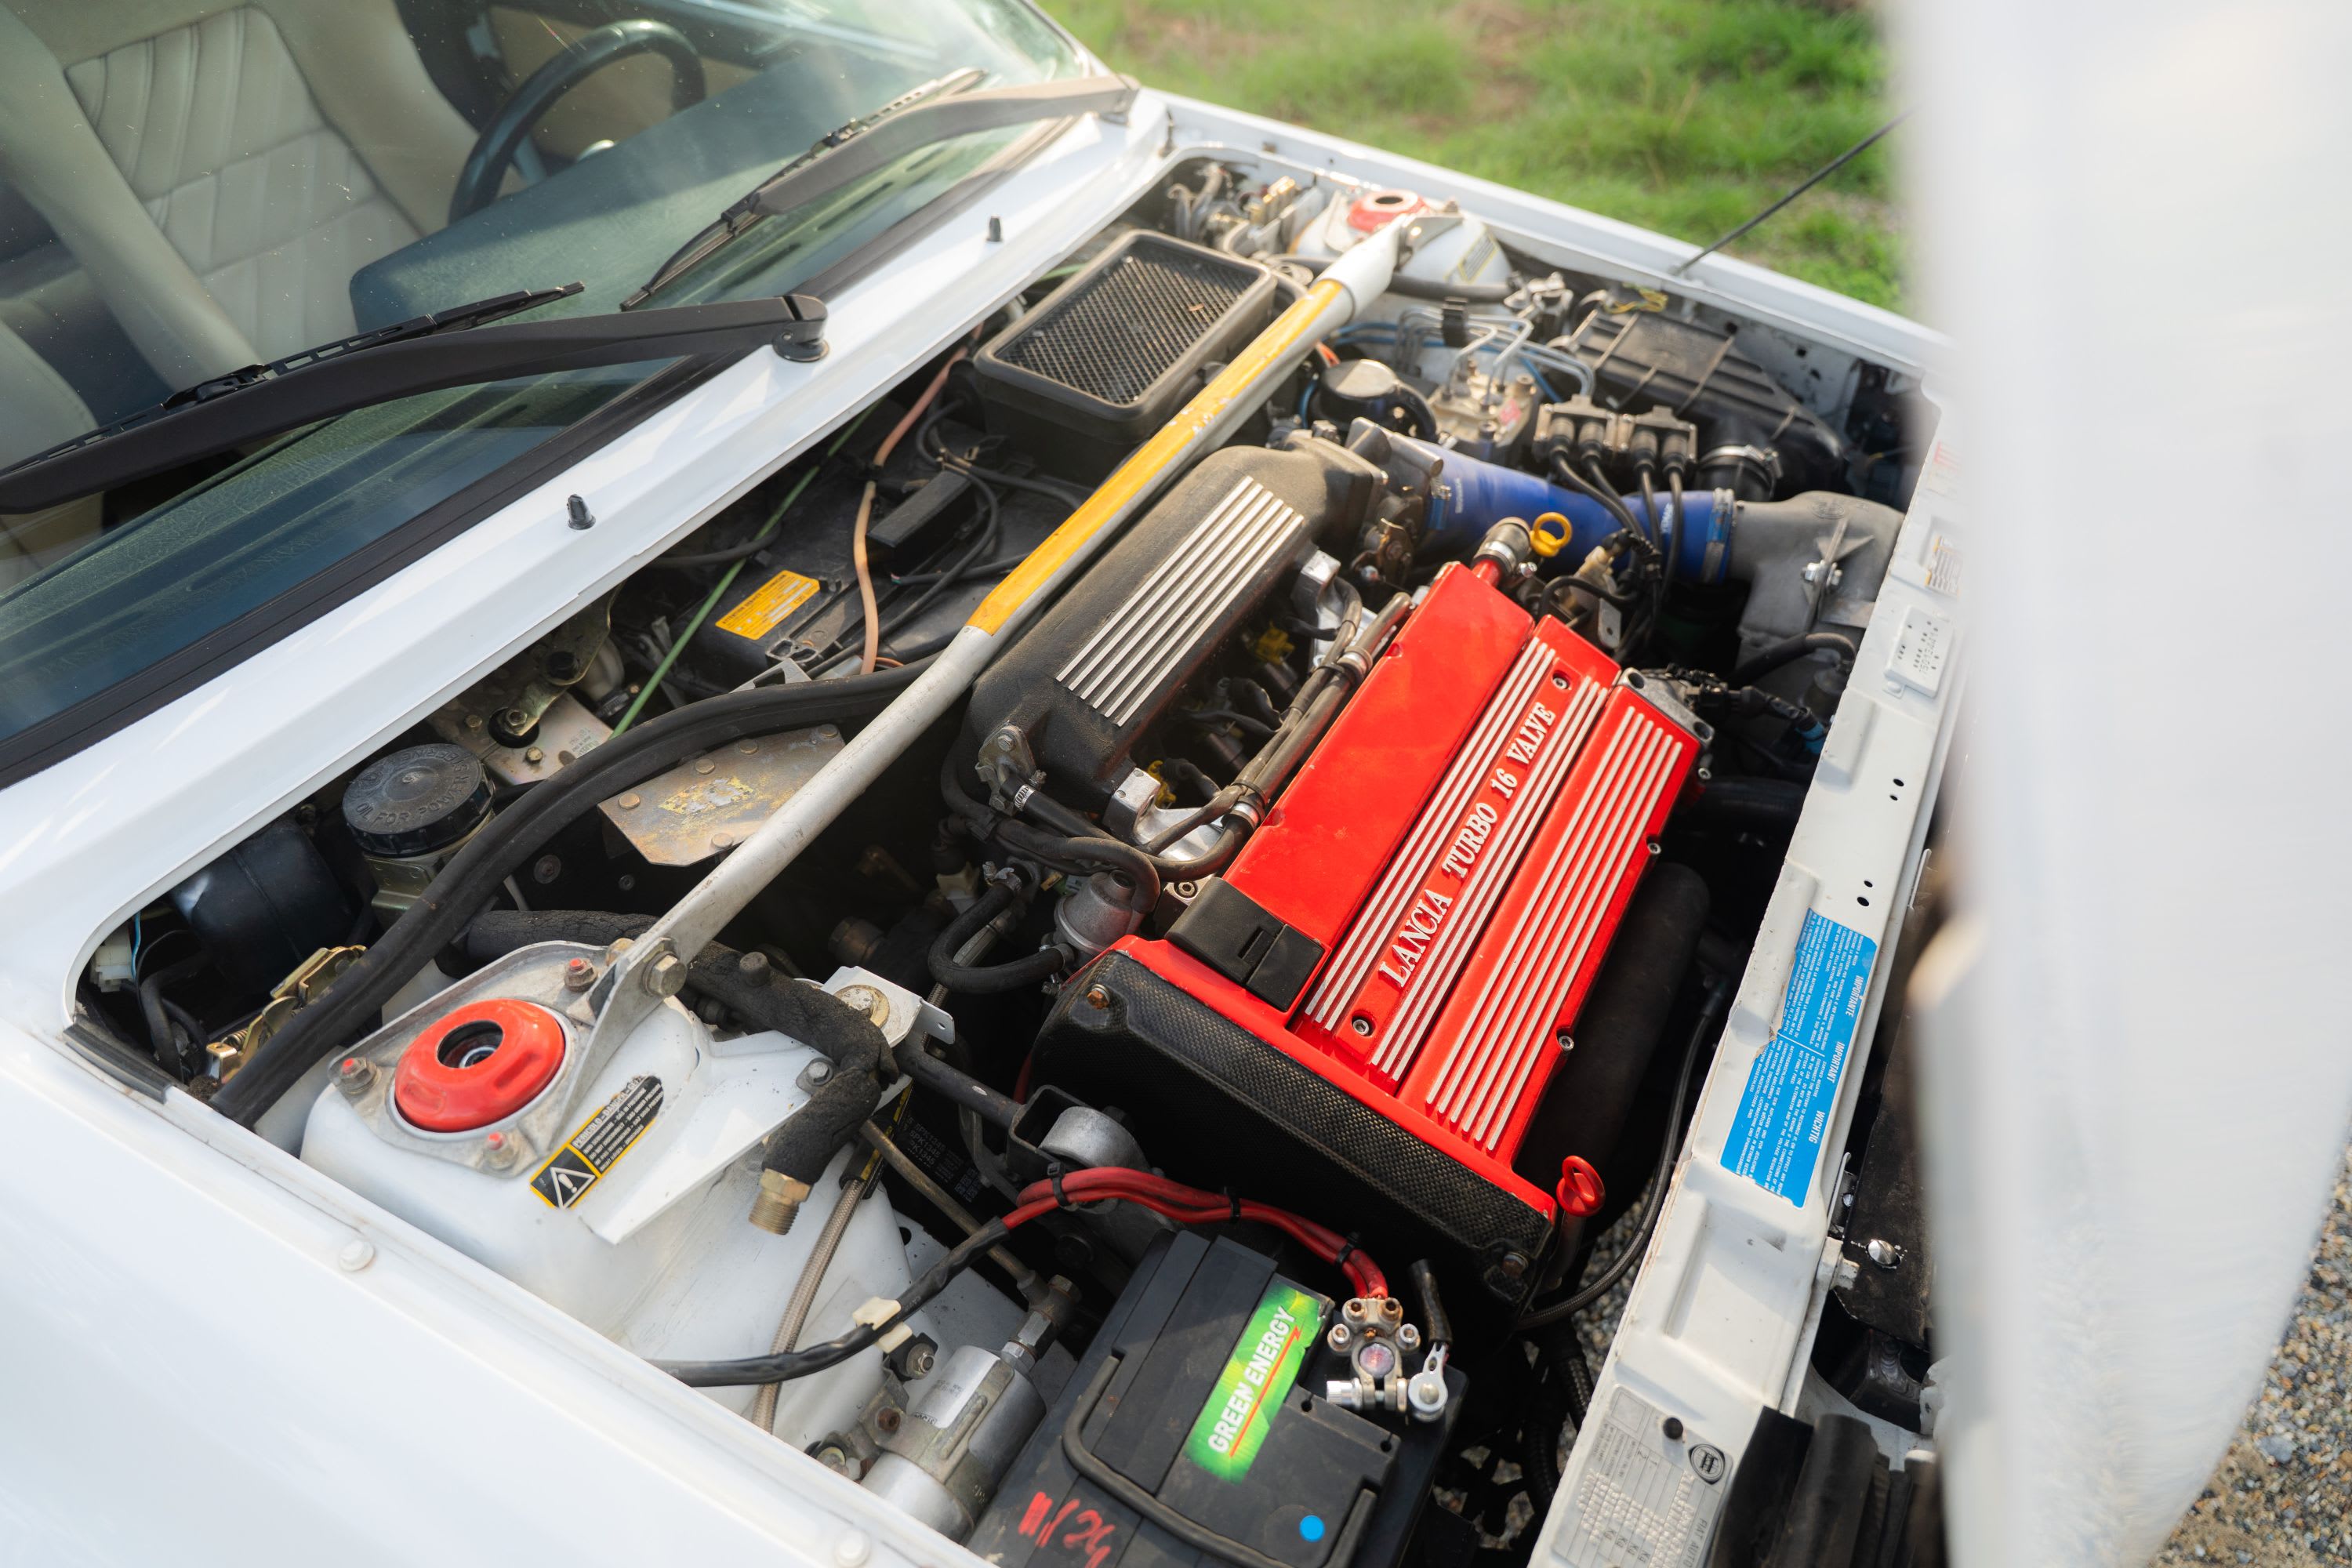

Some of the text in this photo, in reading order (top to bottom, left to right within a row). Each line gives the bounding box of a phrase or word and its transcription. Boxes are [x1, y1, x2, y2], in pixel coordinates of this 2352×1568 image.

[1377, 702, 1555, 987] LANCIA TURBO 16 VALVE
[1846, 975, 1864, 1017] IMPORTANTE
[1827, 1040, 1845, 1082] IMPORTANT
[571, 1116, 603, 1148] PERICOLO
[1809, 1109, 1825, 1144] WICHTIG
[1207, 1304, 1298, 1454] GREEN ENERGY
